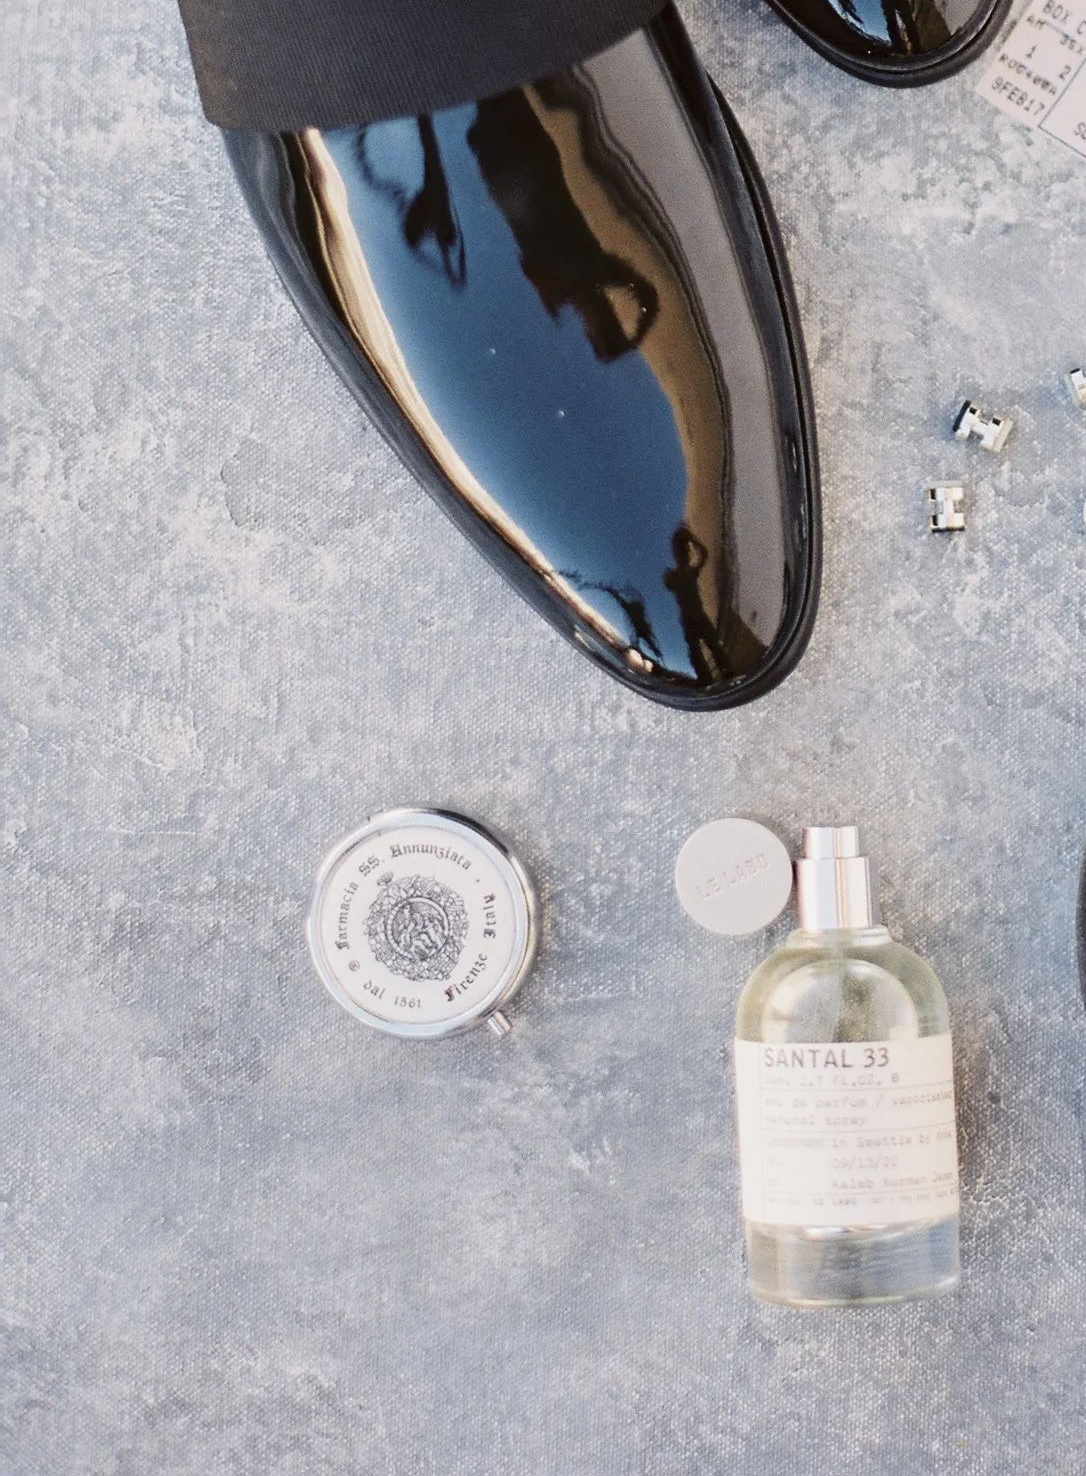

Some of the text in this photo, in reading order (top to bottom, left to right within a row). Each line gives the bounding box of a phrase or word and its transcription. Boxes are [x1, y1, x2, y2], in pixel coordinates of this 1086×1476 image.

[1043, 0, 1070, 23] BOX
[1026, 44, 1071, 79] 1 2
[363, 980, 422, 1009] dal 1561
[764, 1047, 889, 1068] SANTAL 33
